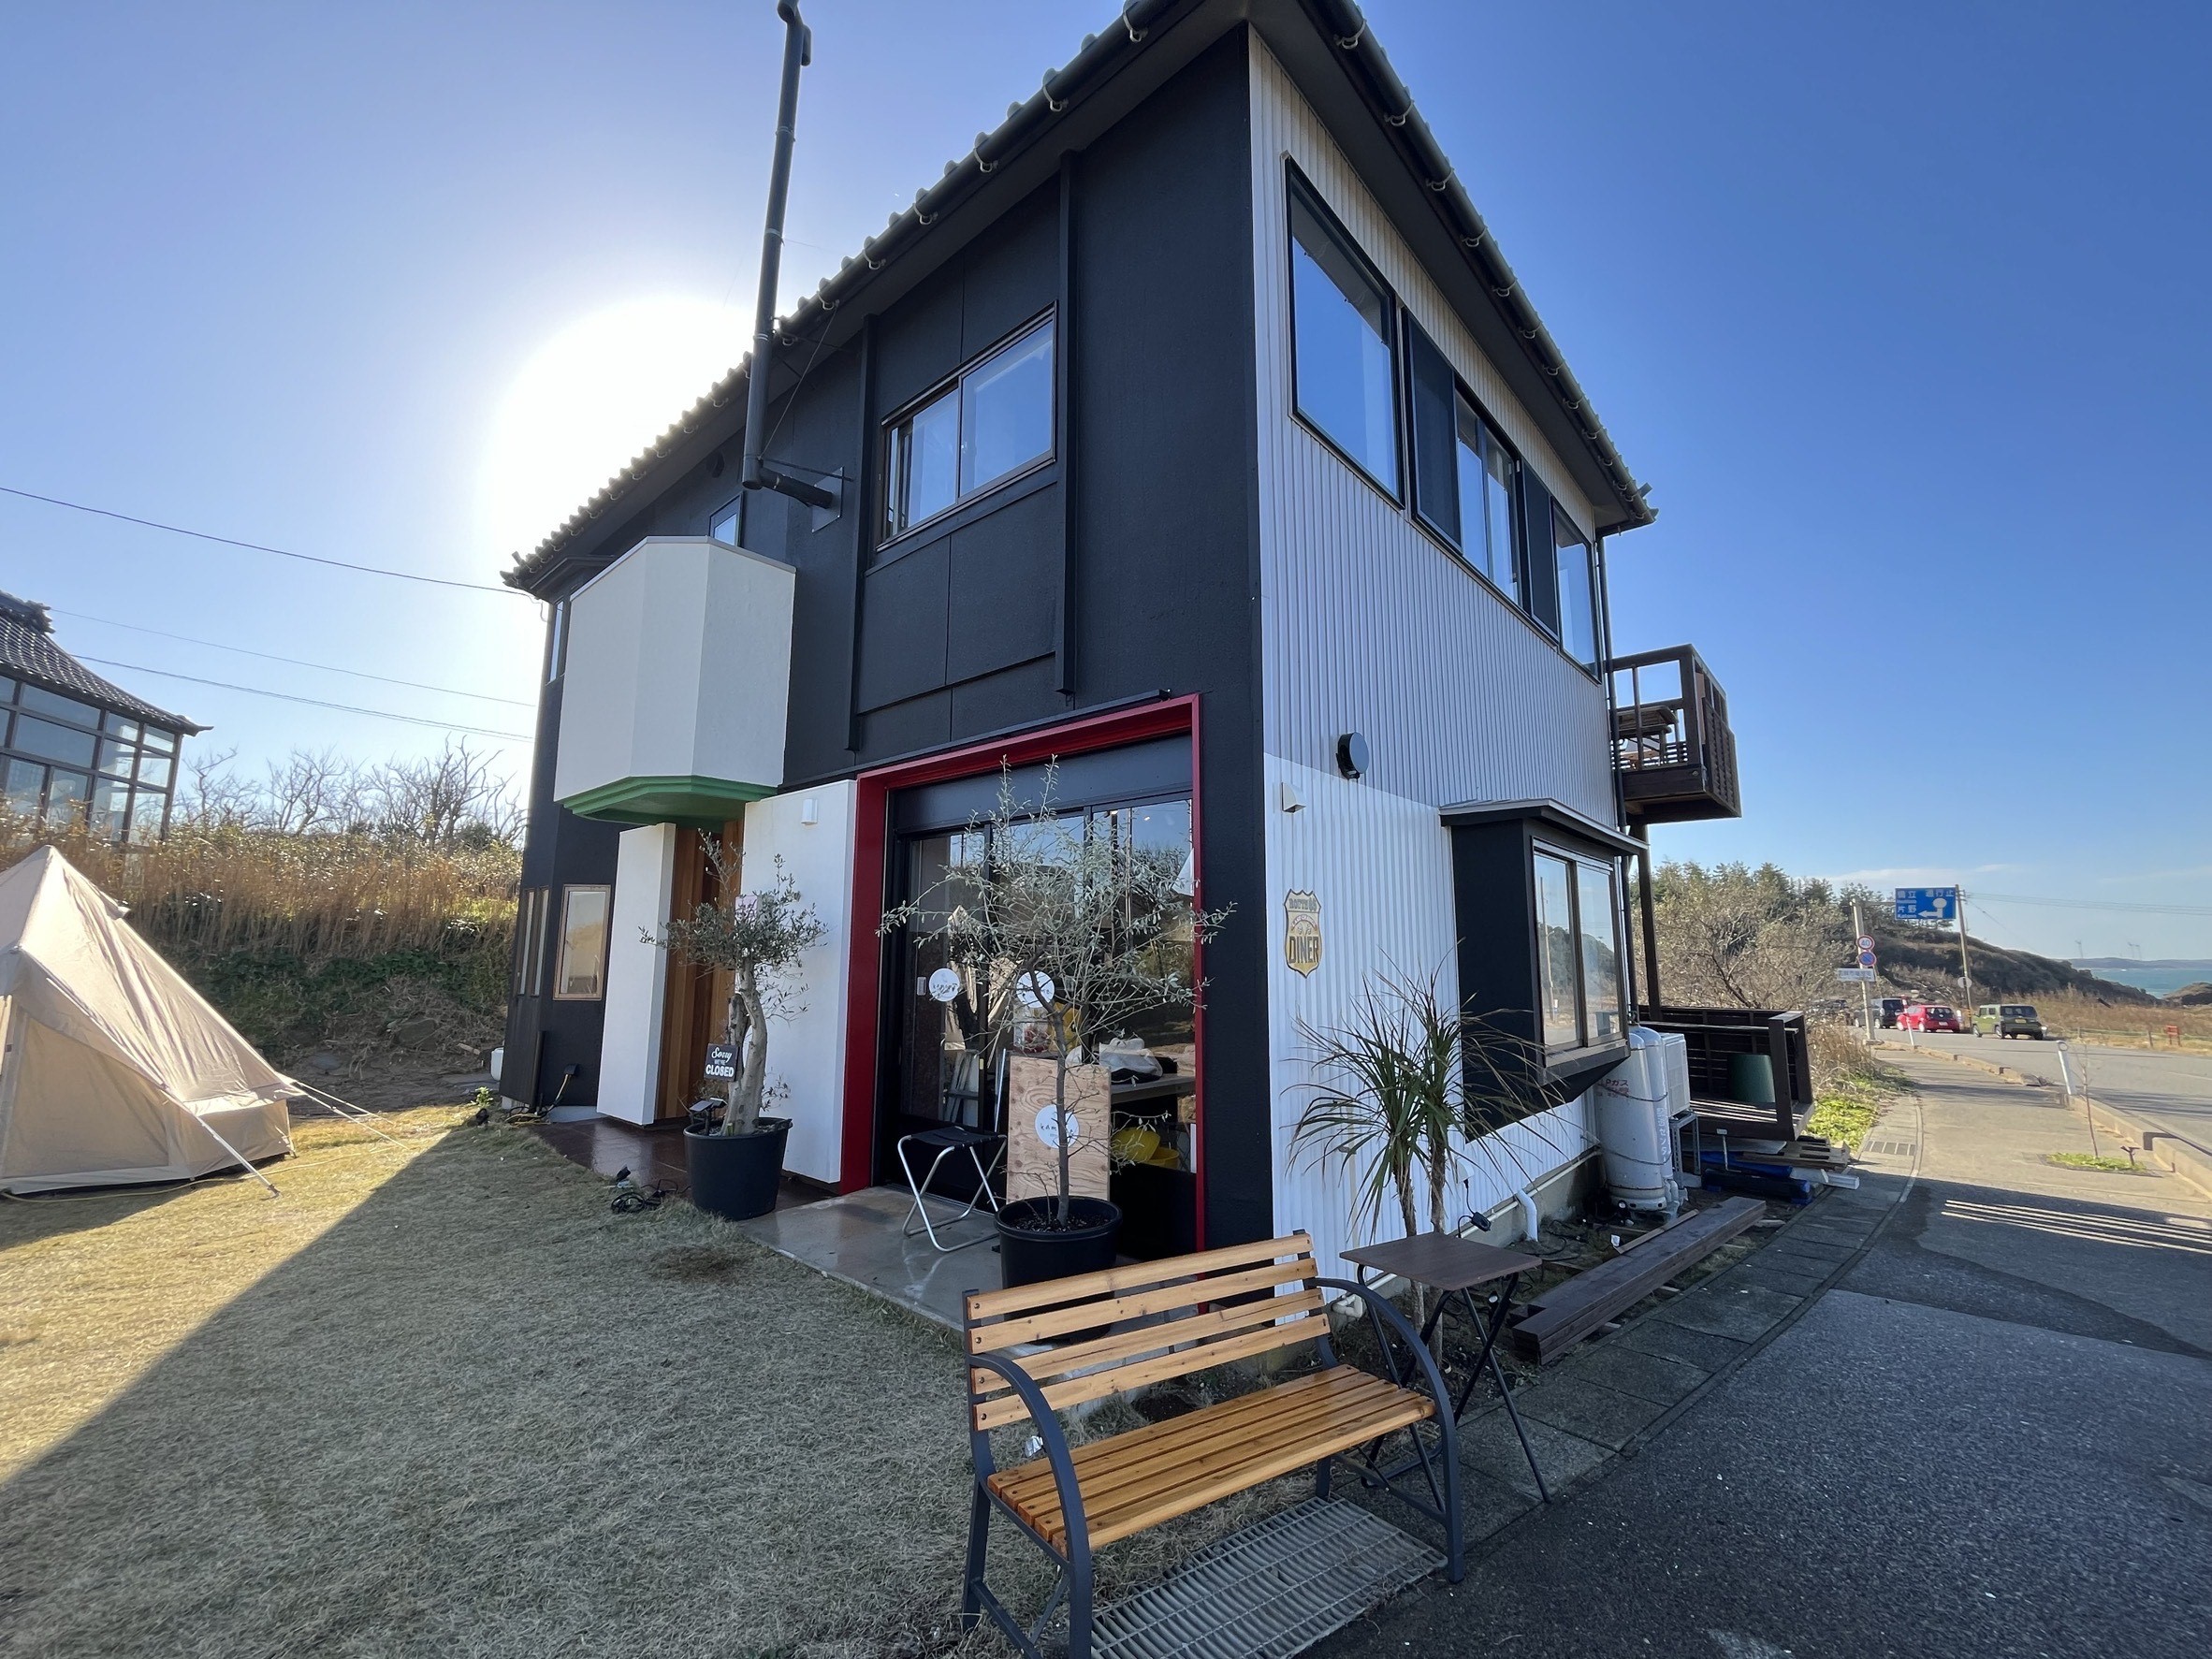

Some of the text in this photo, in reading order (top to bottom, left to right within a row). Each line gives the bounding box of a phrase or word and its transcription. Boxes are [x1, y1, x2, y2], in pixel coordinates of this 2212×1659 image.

[1289, 937, 1318, 963] DINER
[711, 1047, 732, 1062] Sorry
[706, 1064, 734, 1077] CLOSED
